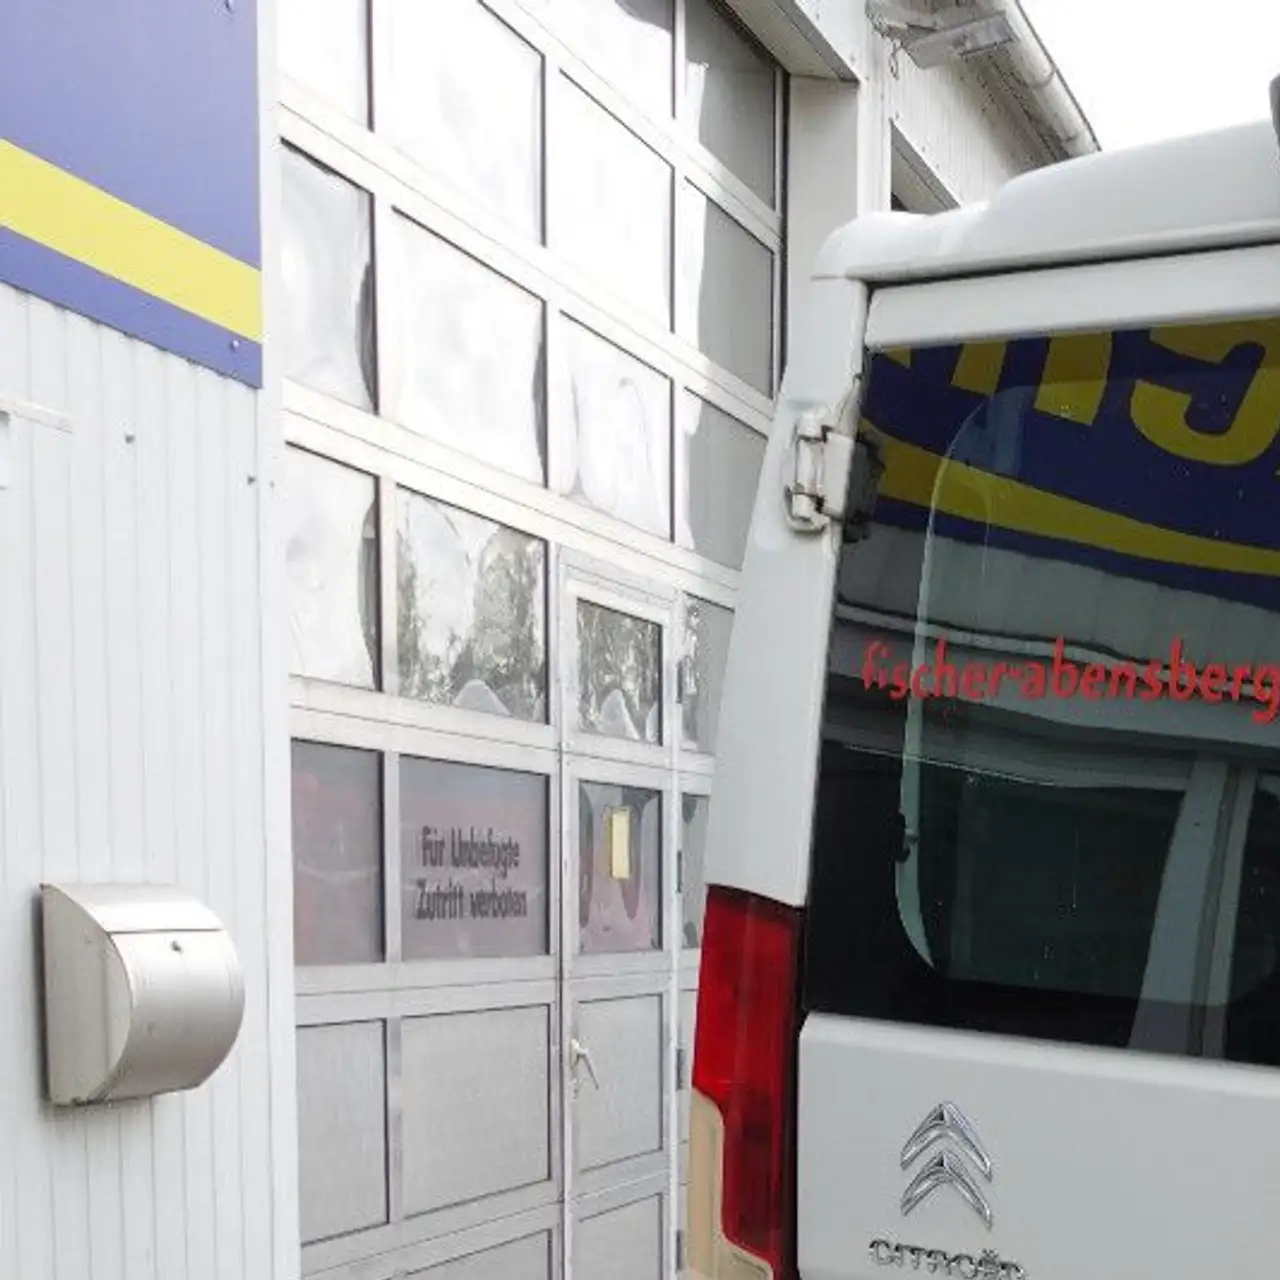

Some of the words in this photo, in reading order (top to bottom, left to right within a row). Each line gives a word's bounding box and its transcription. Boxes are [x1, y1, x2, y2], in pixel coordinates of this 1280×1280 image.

[422, 825, 445, 867] Für
[451, 827, 520, 880] Unbefugte
[416, 877, 464, 920] Zutritt
[469, 878, 528, 920] verboten
